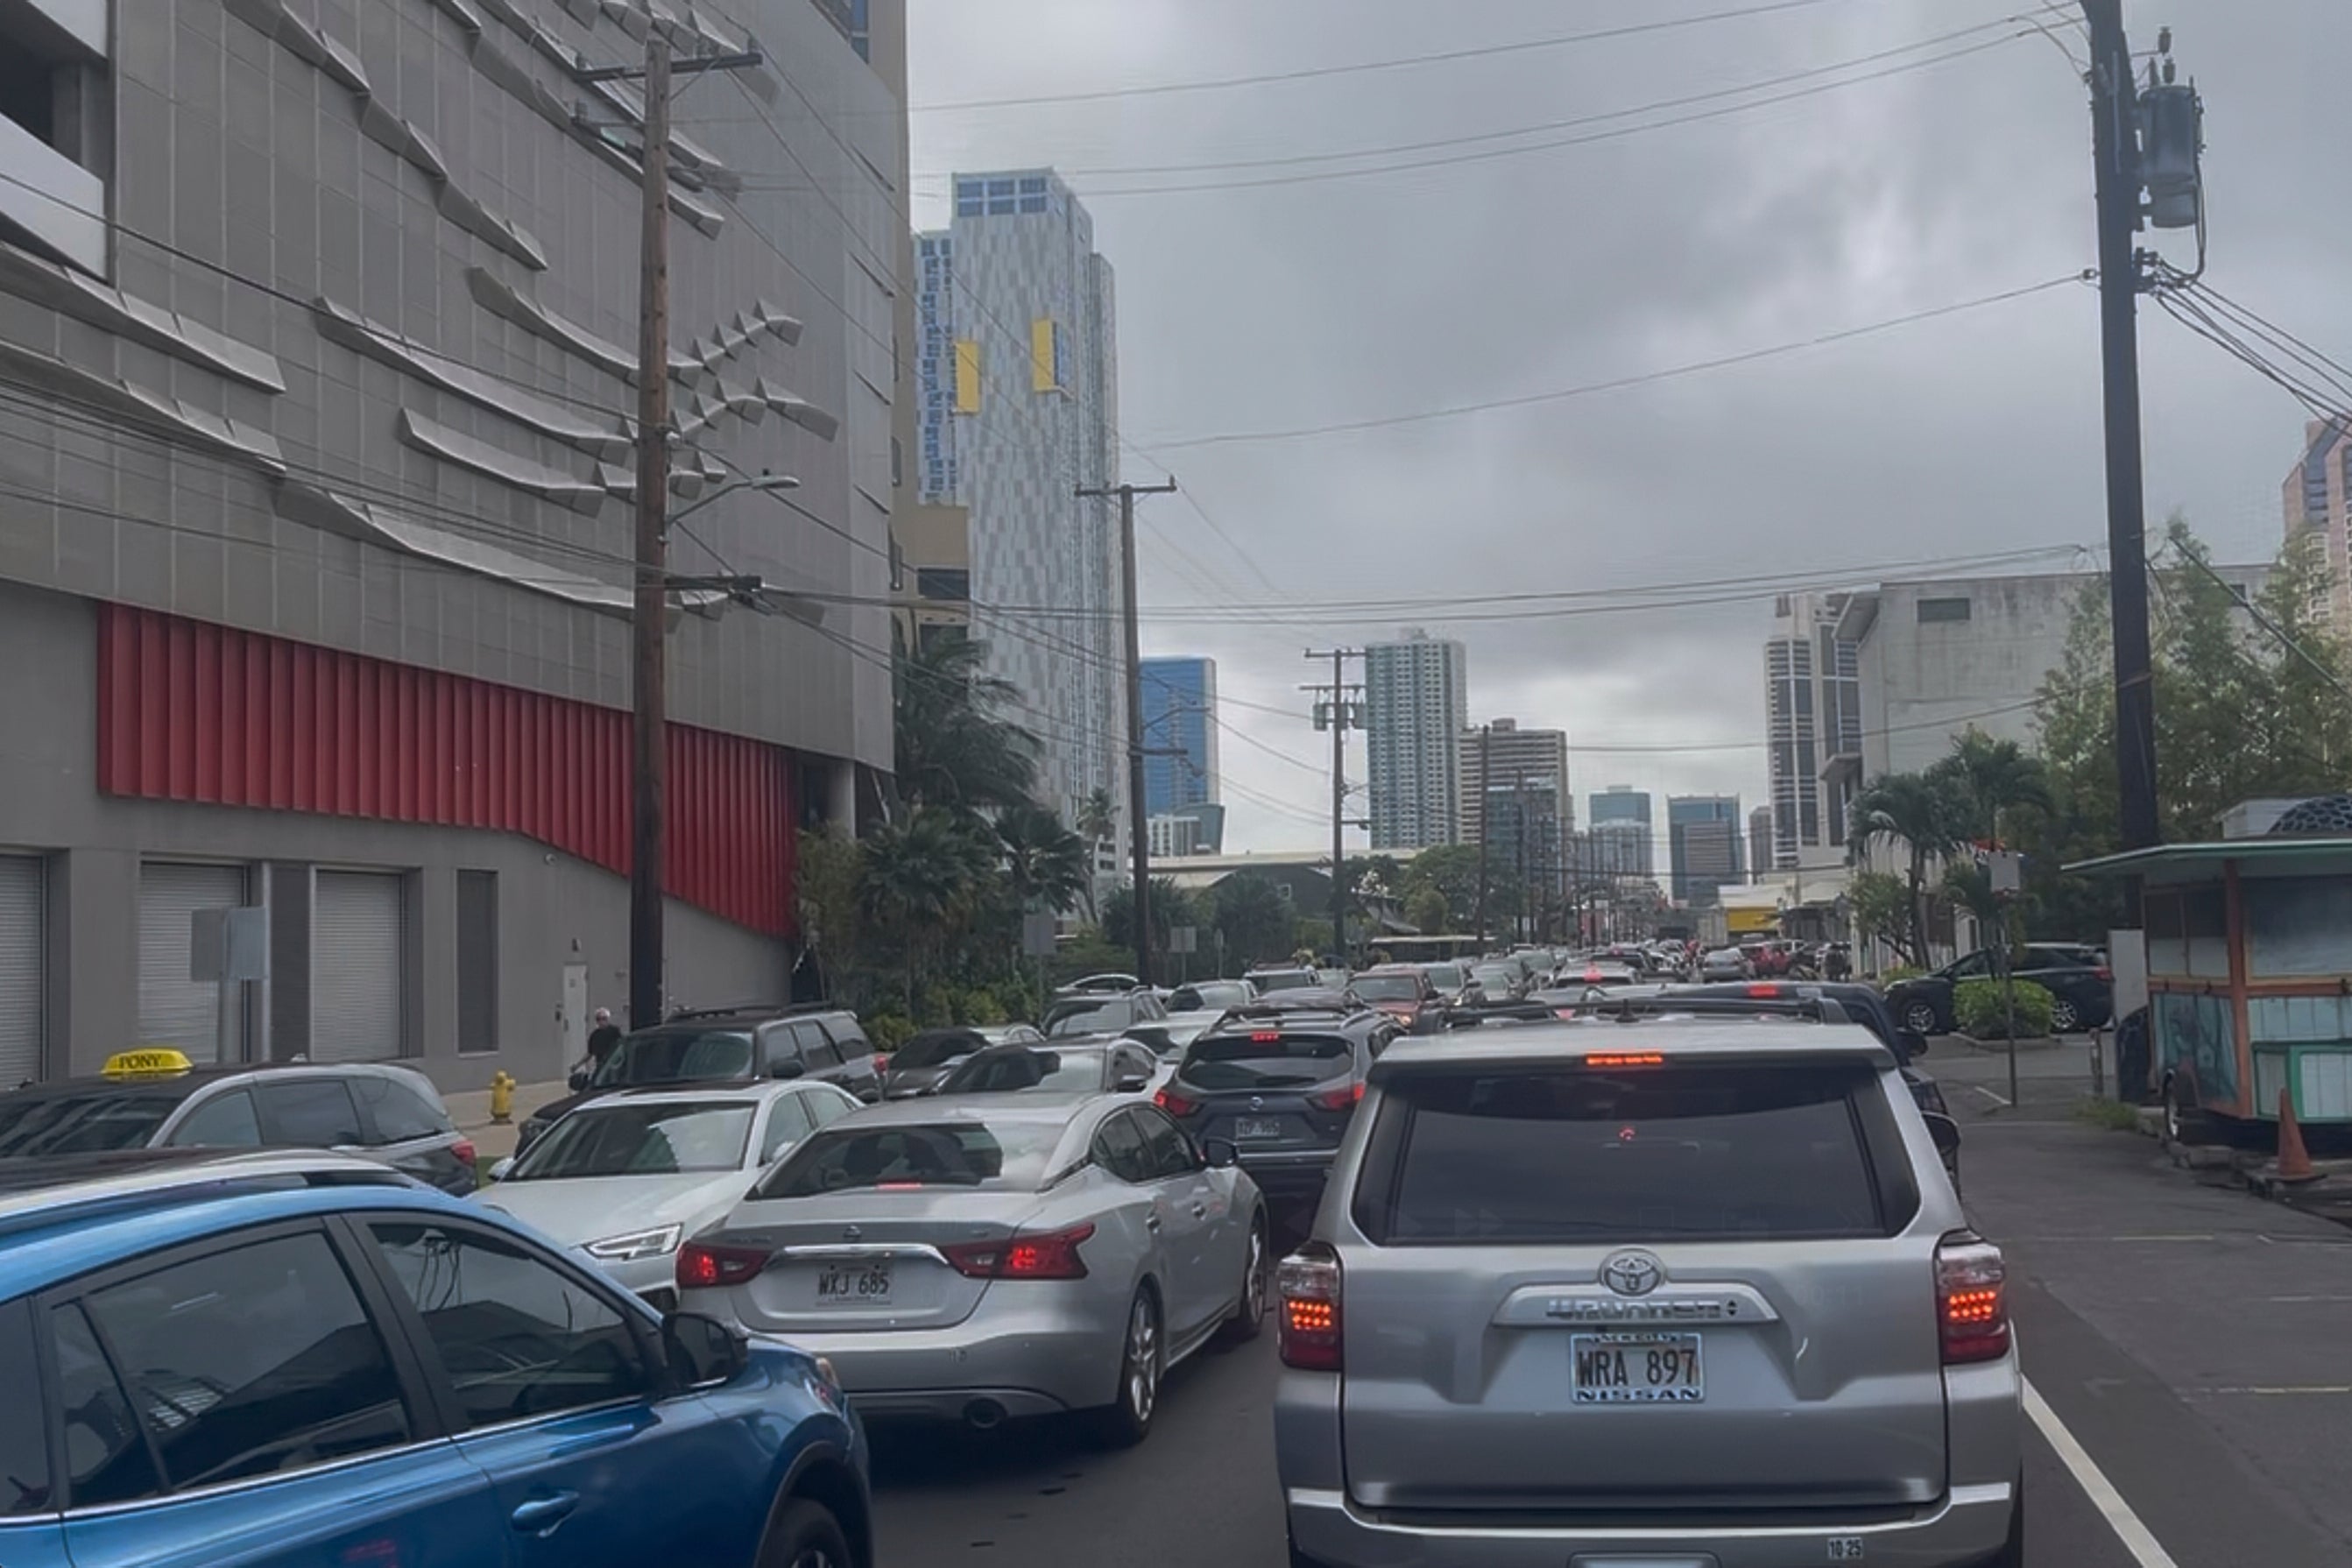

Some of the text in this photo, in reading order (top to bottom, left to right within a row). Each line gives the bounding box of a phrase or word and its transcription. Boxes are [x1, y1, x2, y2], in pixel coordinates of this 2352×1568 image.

[818, 1273, 850, 1296] WXJ
[858, 1272, 890, 1295] 685
[1577, 1349, 1696, 1386] WRA 897
[1576, 1389, 1699, 1401] NISSAN
